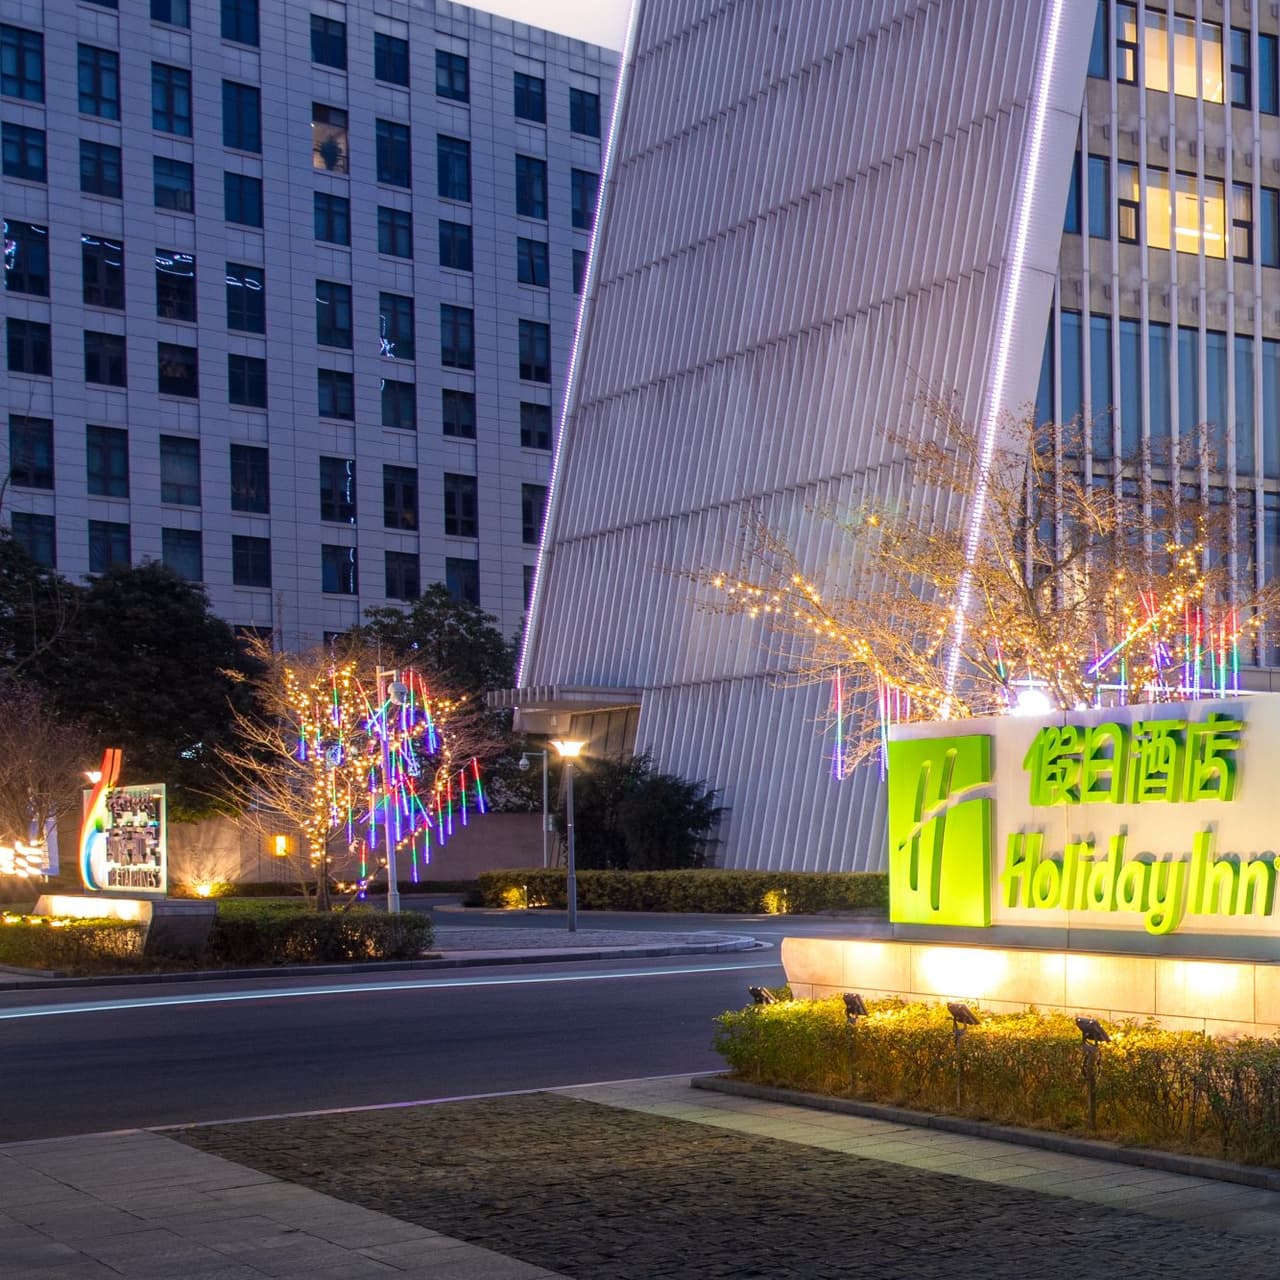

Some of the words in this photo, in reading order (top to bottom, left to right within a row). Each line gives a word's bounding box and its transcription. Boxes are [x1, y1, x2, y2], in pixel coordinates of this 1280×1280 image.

[1022, 712, 1246, 807] 假日酒店
[1000, 831, 1188, 935] Holiday
